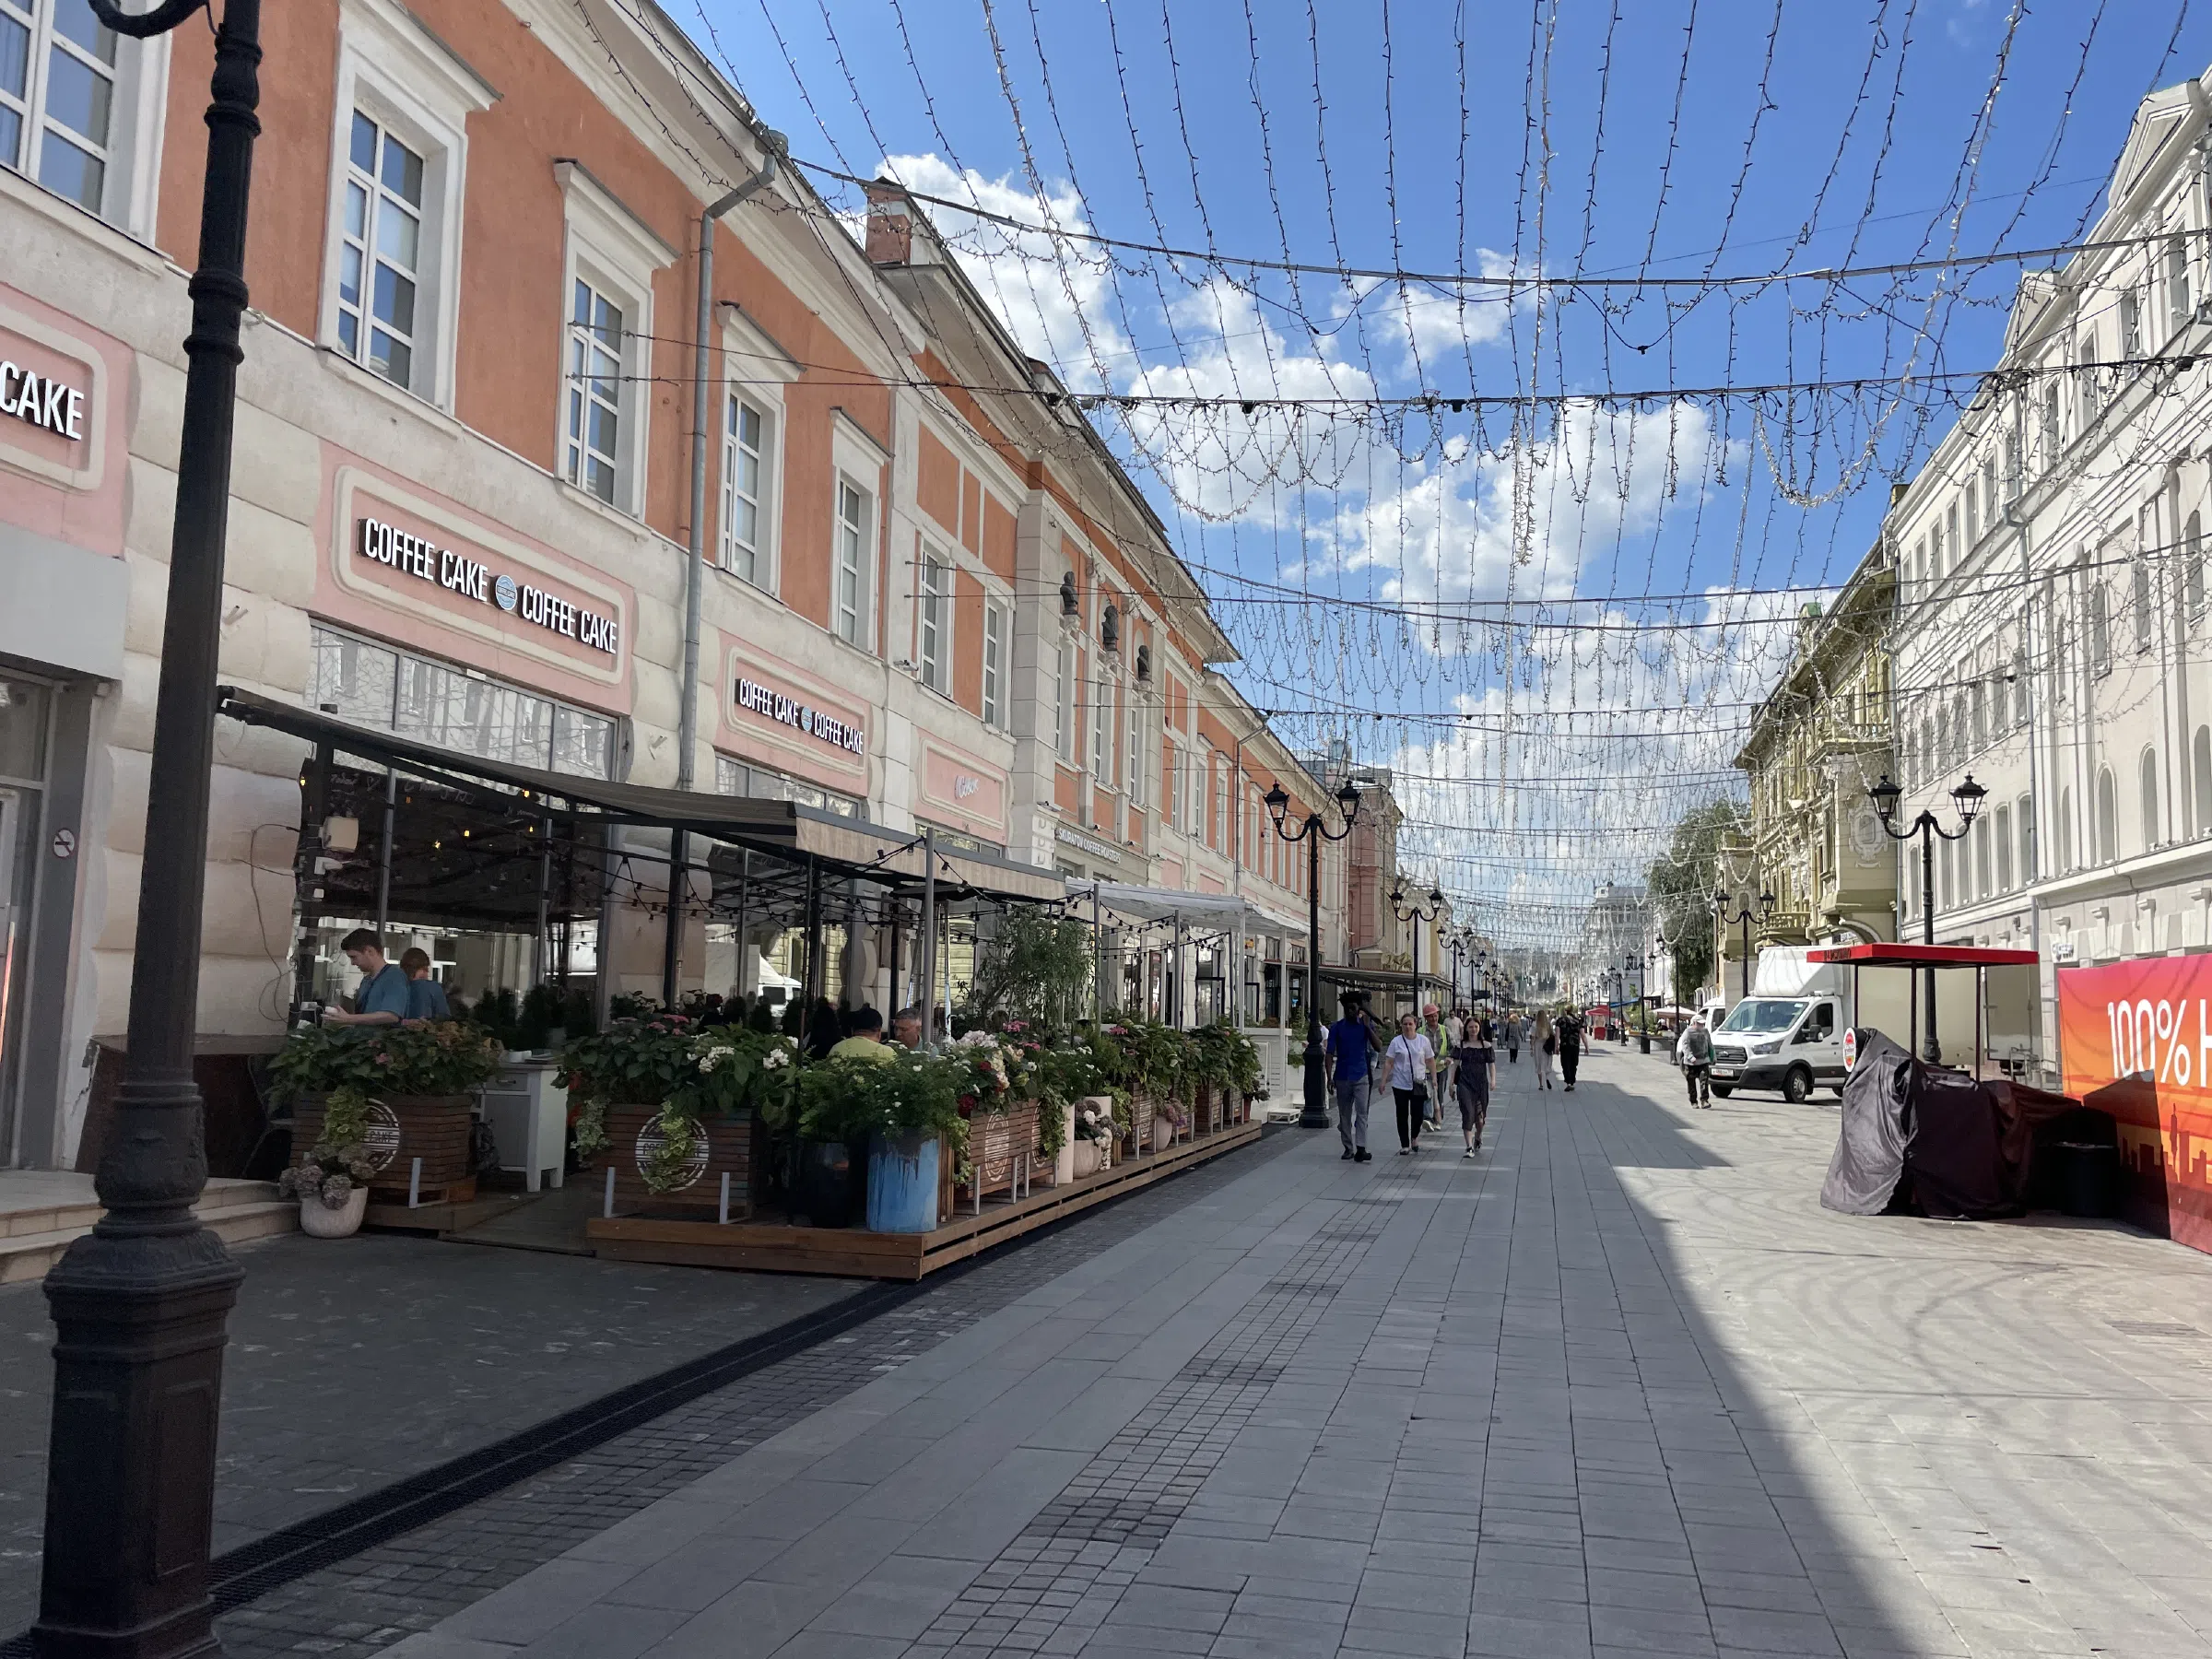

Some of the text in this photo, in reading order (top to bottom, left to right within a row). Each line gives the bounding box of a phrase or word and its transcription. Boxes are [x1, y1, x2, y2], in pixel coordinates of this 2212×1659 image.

[0, 360, 85, 441] CAKE
[364, 517, 488, 603] COFFEE CAKE
[522, 584, 618, 654] COFFEE CAKE
[739, 677, 799, 727] COFFEE CAKE
[814, 711, 864, 755] COFFEE CAKE
[1059, 827, 1084, 849] SKURATOV
[1083, 838, 1101, 855] COFFEE
[2107, 998, 2191, 1087] 100%
